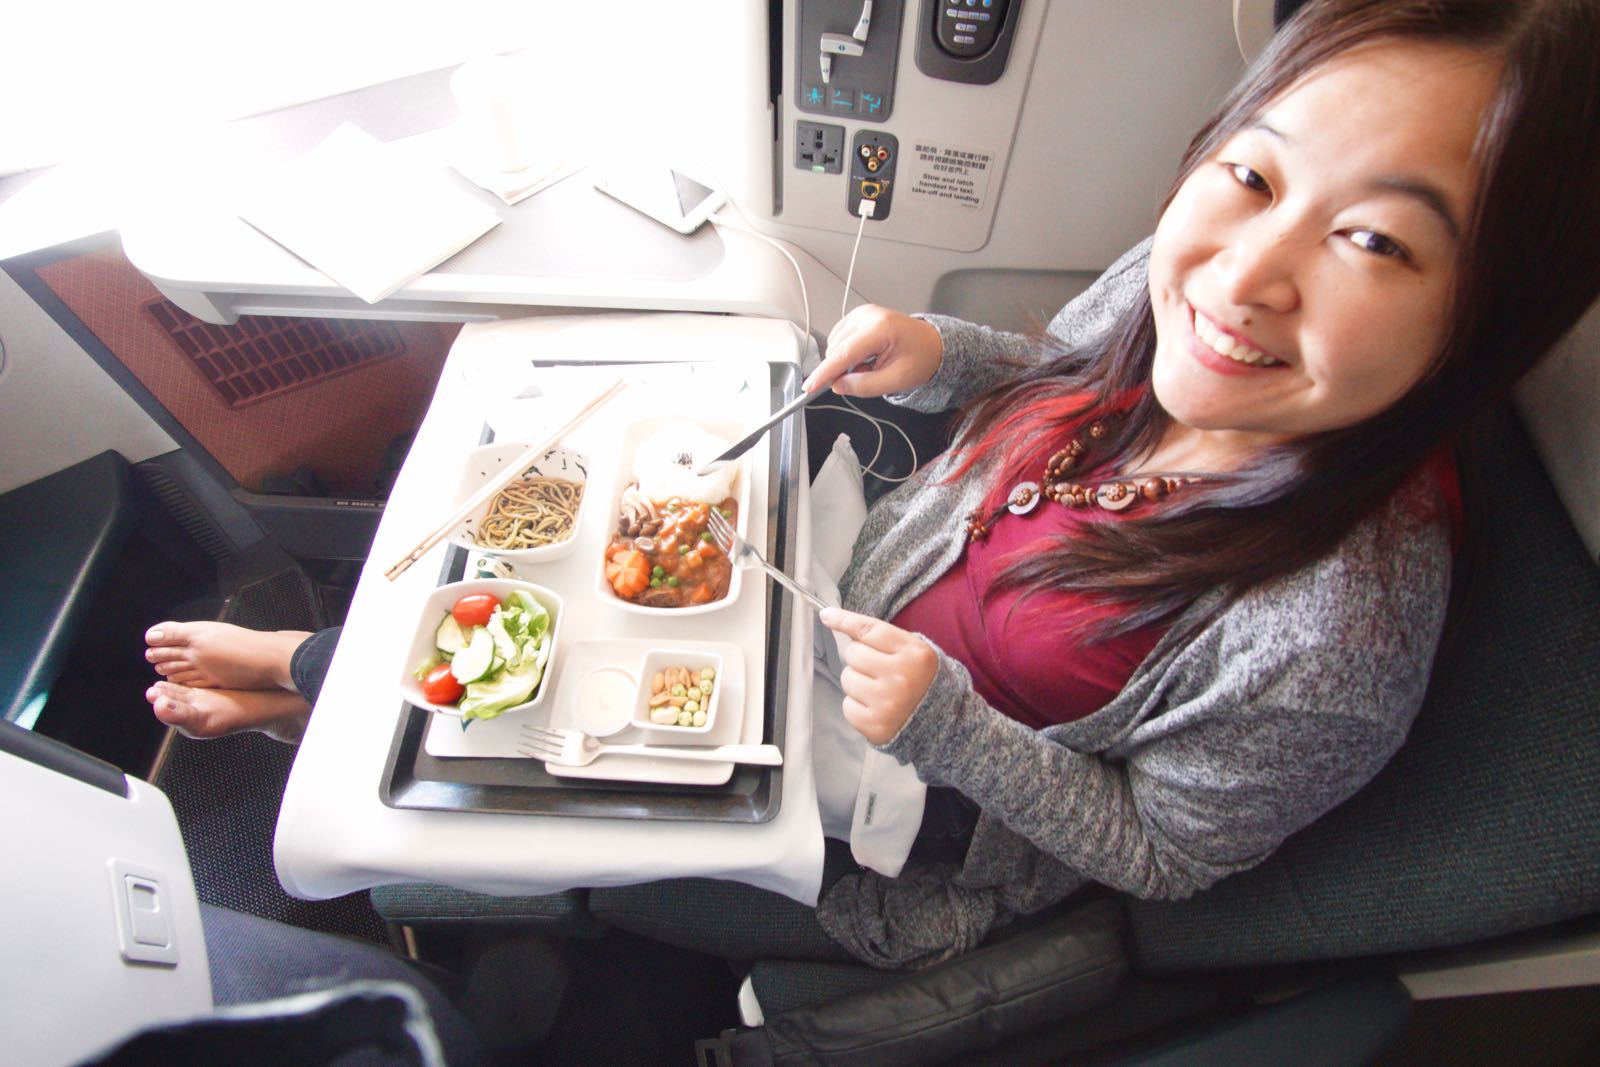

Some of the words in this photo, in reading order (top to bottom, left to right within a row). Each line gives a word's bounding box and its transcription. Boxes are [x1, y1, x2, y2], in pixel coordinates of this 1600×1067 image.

[919, 180, 947, 190] handset
[942, 176, 955, 184] and
[957, 178, 974, 187] latch
[912, 186, 938, 195] take-off
[939, 191, 952, 199] and
[954, 193, 980, 204] landing
